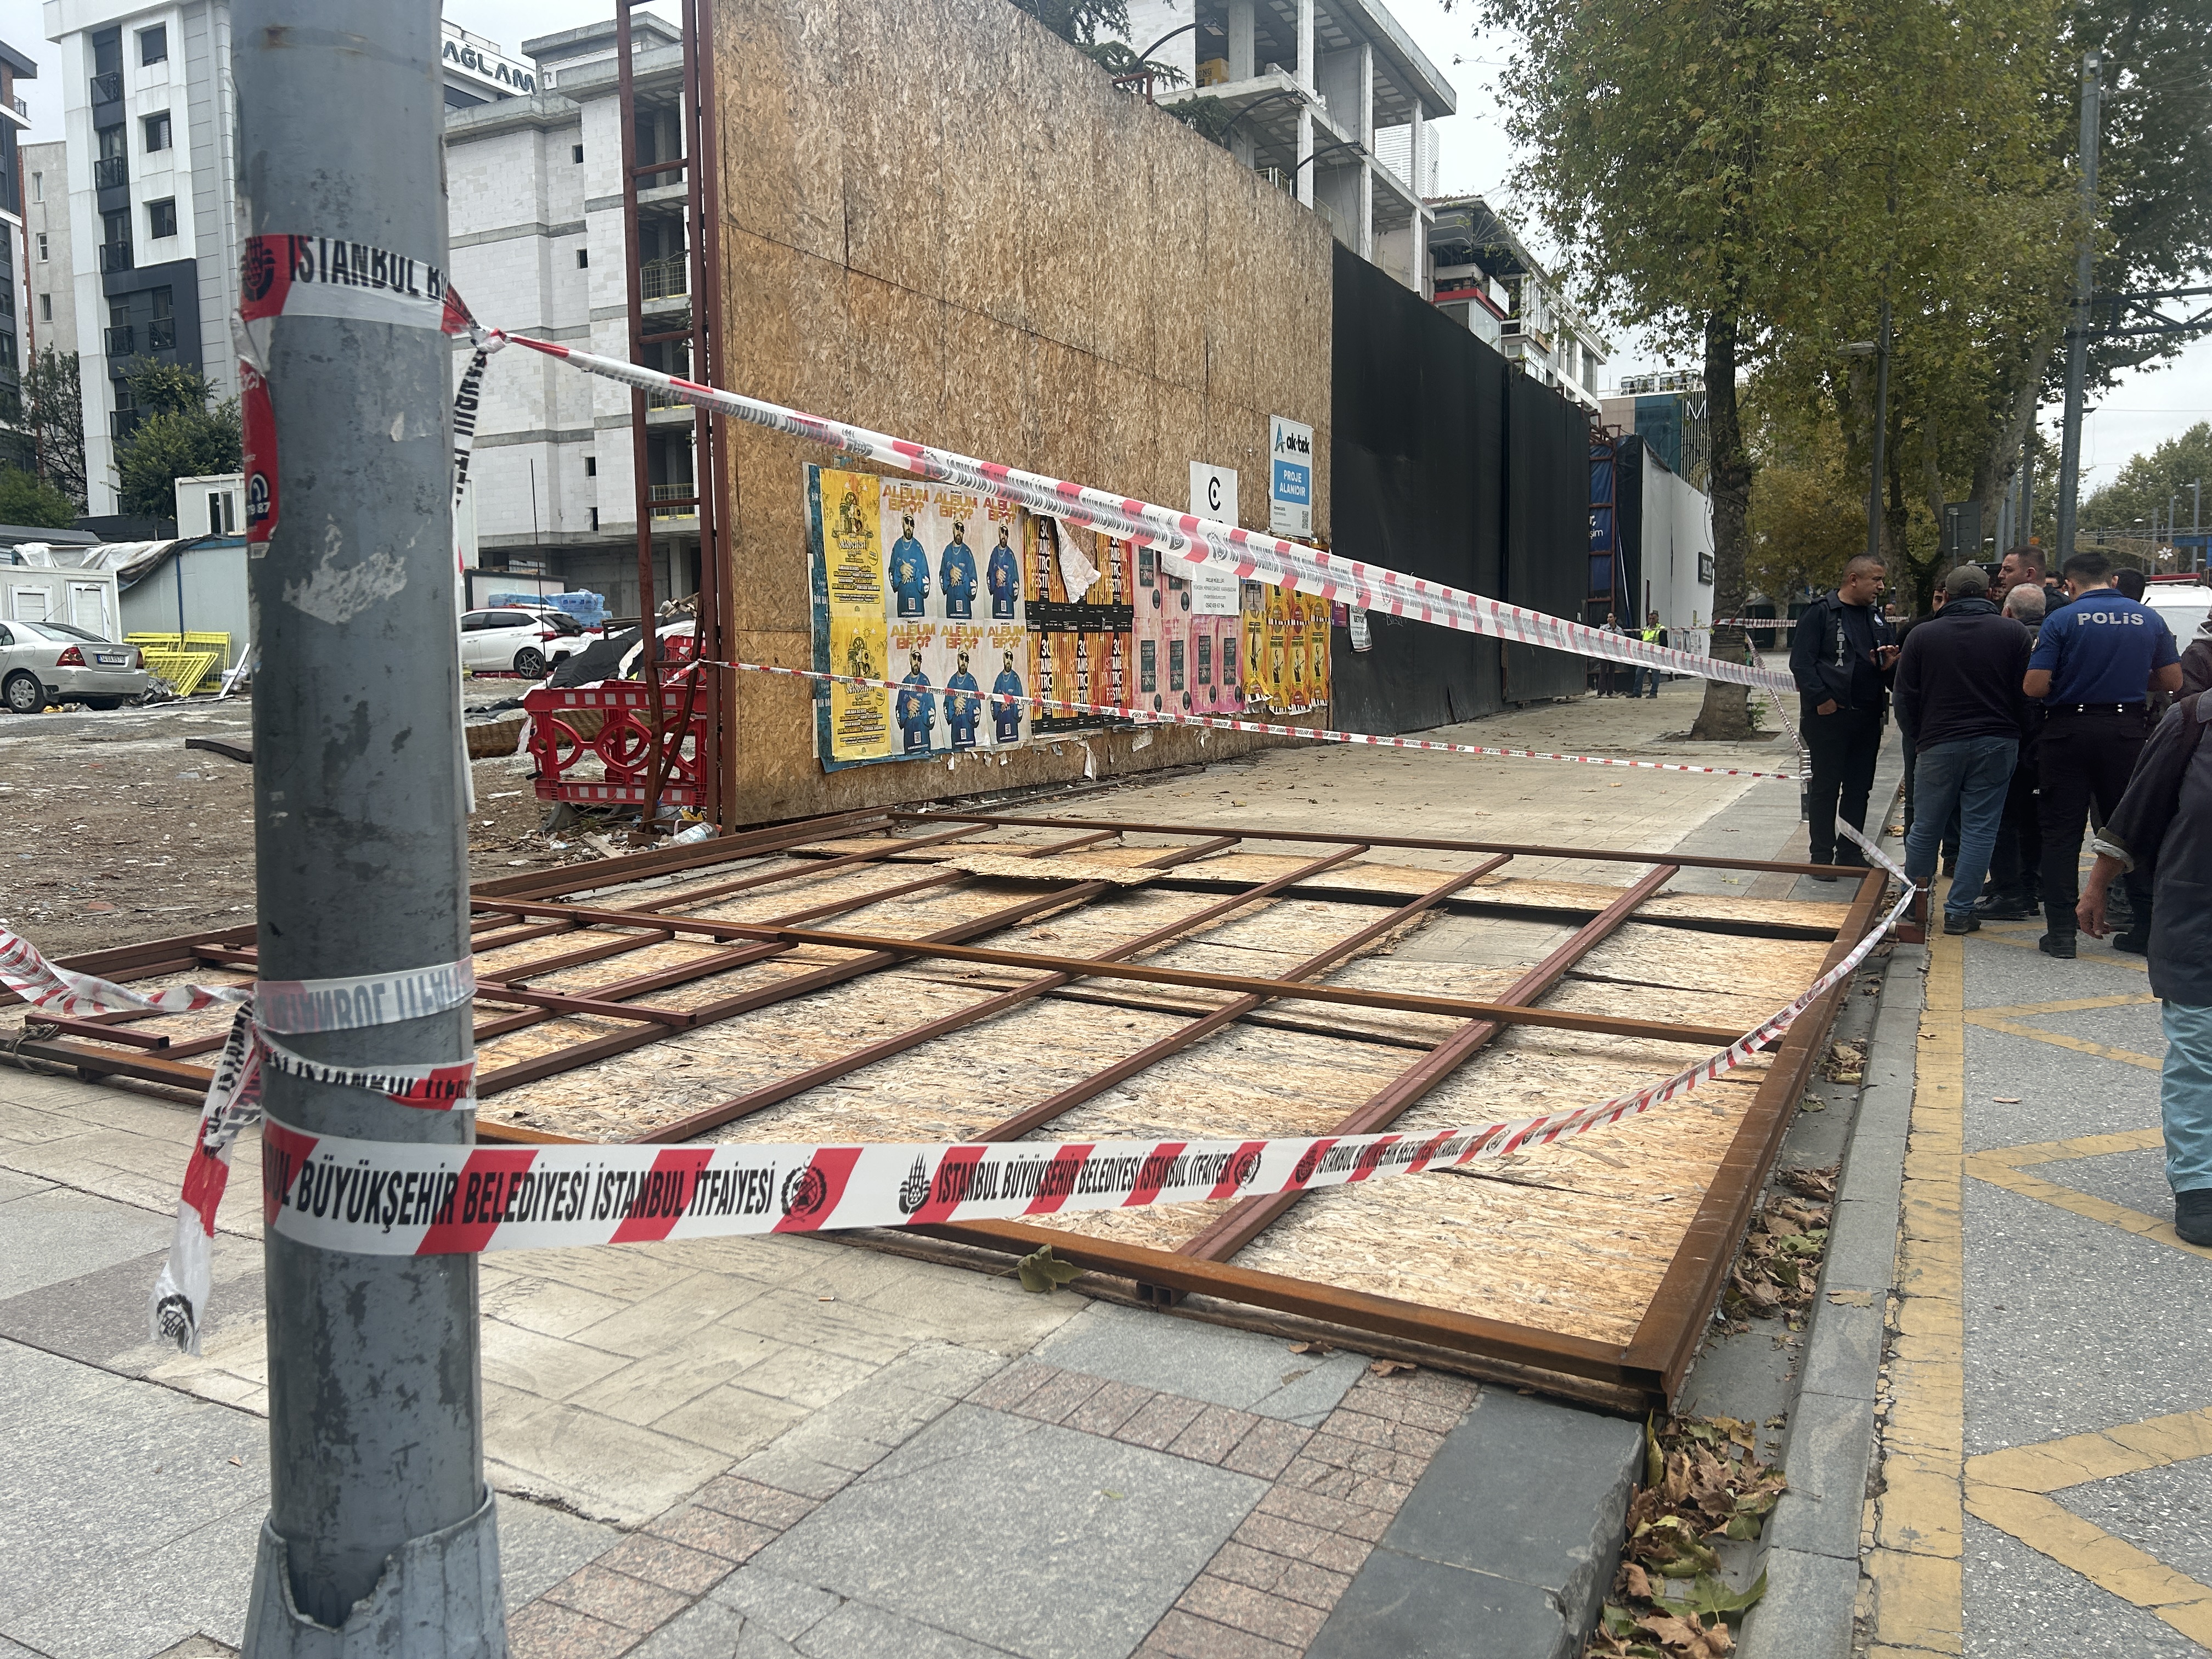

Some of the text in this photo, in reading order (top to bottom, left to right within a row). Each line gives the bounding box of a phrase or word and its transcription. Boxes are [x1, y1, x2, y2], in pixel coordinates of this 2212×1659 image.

[1283, 469, 1302, 483] PROJE
[882, 485, 929, 502] ALBUM
[1279, 483, 1306, 497] ALANIDIR
[889, 498, 924, 514] BRO?
[934, 492, 978, 509] ALBUM
[940, 505, 974, 520] BRO?
[988, 509, 1017, 525] BRO?
[890, 623, 936, 637] ALBUM
[940, 625, 984, 638] ALBUM
[987, 625, 1025, 638] ALBUM
[896, 635, 931, 650] BRO?
[946, 637, 979, 649] BRO?
[992, 636, 1022, 649] BRO?
[936, 1149, 1235, 1203] İSTANBUL BÜYÜKŞEHİR BELEDİYESİ İSTANBUL İTFAİYESİ
[296, 1154, 461, 1233] BÜYÜKŞEHİR
[462, 1161, 591, 1224] BELEDİYESİ
[590, 1161, 686, 1221] İSTANBUL
[687, 1160, 776, 1217] İTFAİYESİ
